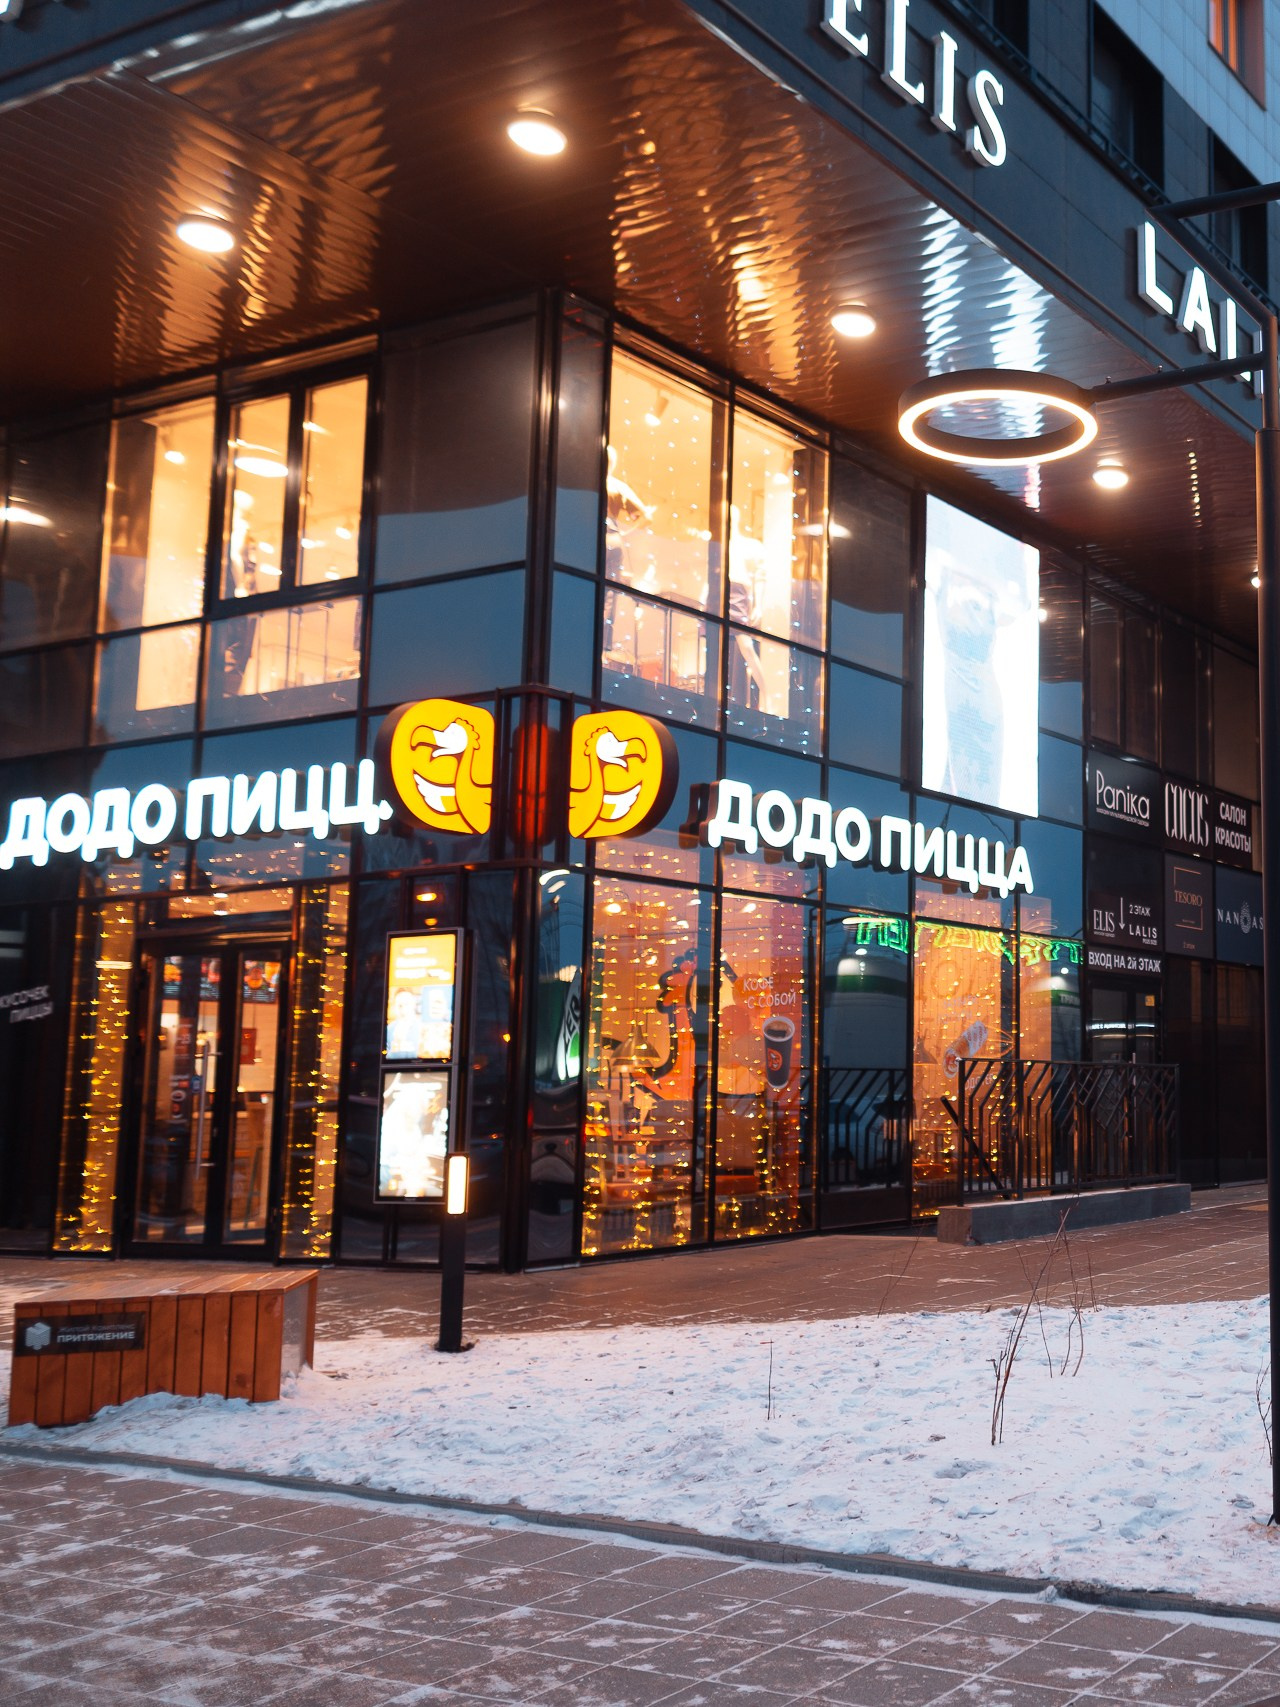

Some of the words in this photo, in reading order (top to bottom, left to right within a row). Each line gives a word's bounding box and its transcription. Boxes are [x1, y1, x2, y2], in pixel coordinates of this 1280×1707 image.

[1096, 770, 1150, 820] Panika
[0, 783, 177, 870] ДОДО
[185, 758, 394, 840] ПИЦЦ
[1219, 802, 1247, 826] САЛОН
[708, 778, 871, 868] ДОДО
[880, 815, 1034, 899] ПИЦЦА
[1215, 826, 1252, 853] КРАСОТЫ
[1174, 890, 1202, 907] TESORO
[1093, 909, 1115, 933] ELIS
[1129, 904, 1133, 914] 2
[1134, 905, 1151, 917] ЭТАЖ
[1129, 924, 1158, 939] LALIS
[1088, 951, 1112, 969] ВХОД
[1113, 954, 1125, 968] НА
[1127, 956, 1137, 969] 2й
[1138, 958, 1161, 973] ЭТАЖ
[743, 976, 774, 991] КОФЕ
[747, 996, 755, 1009] С
[759, 988, 796, 1008] СОБОЙ
[56, 1331, 136, 1343] ПРИТЯЖЕНИЕ
